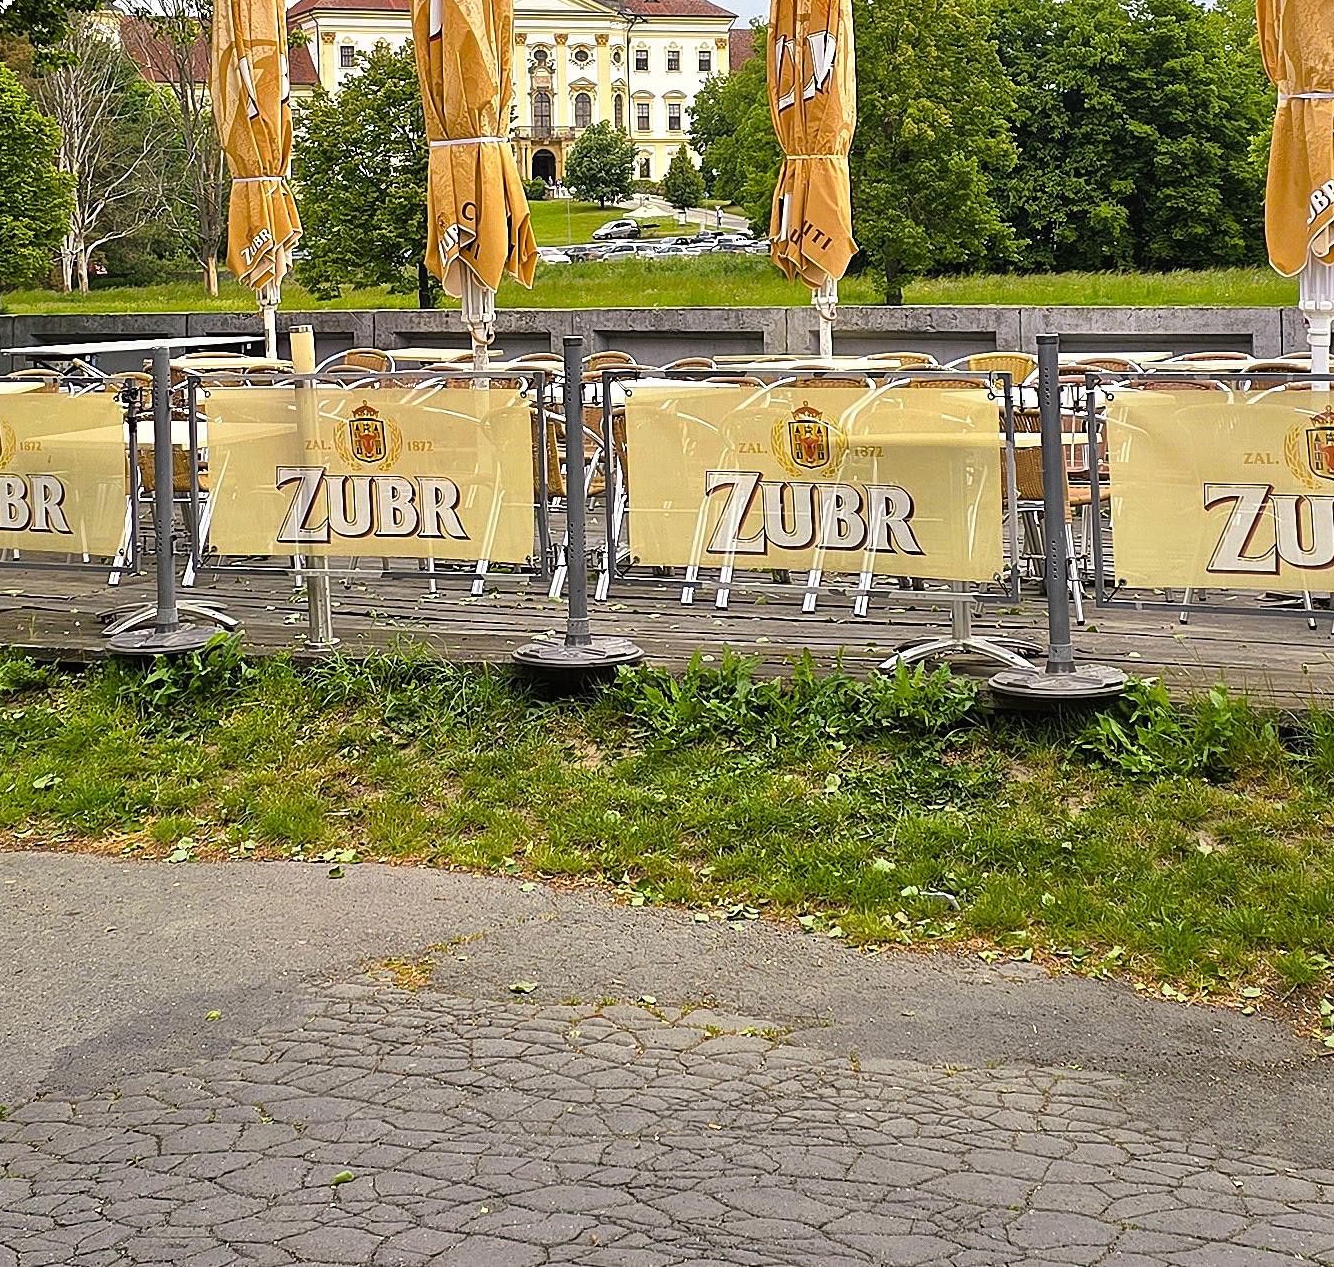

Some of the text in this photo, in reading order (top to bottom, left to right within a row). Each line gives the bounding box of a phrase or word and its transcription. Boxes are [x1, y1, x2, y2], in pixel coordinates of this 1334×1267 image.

[240, 228, 273, 266] ZUBR
[19, 441, 42, 451] 1872
[305, 441, 434, 452] ZAL. 1872
[739, 443, 884, 457] ZAL. 1872
[1243, 453, 1280, 465] ZAL.
[275, 466, 472, 544] ZUBR
[705, 470, 926, 556] ZUBR
